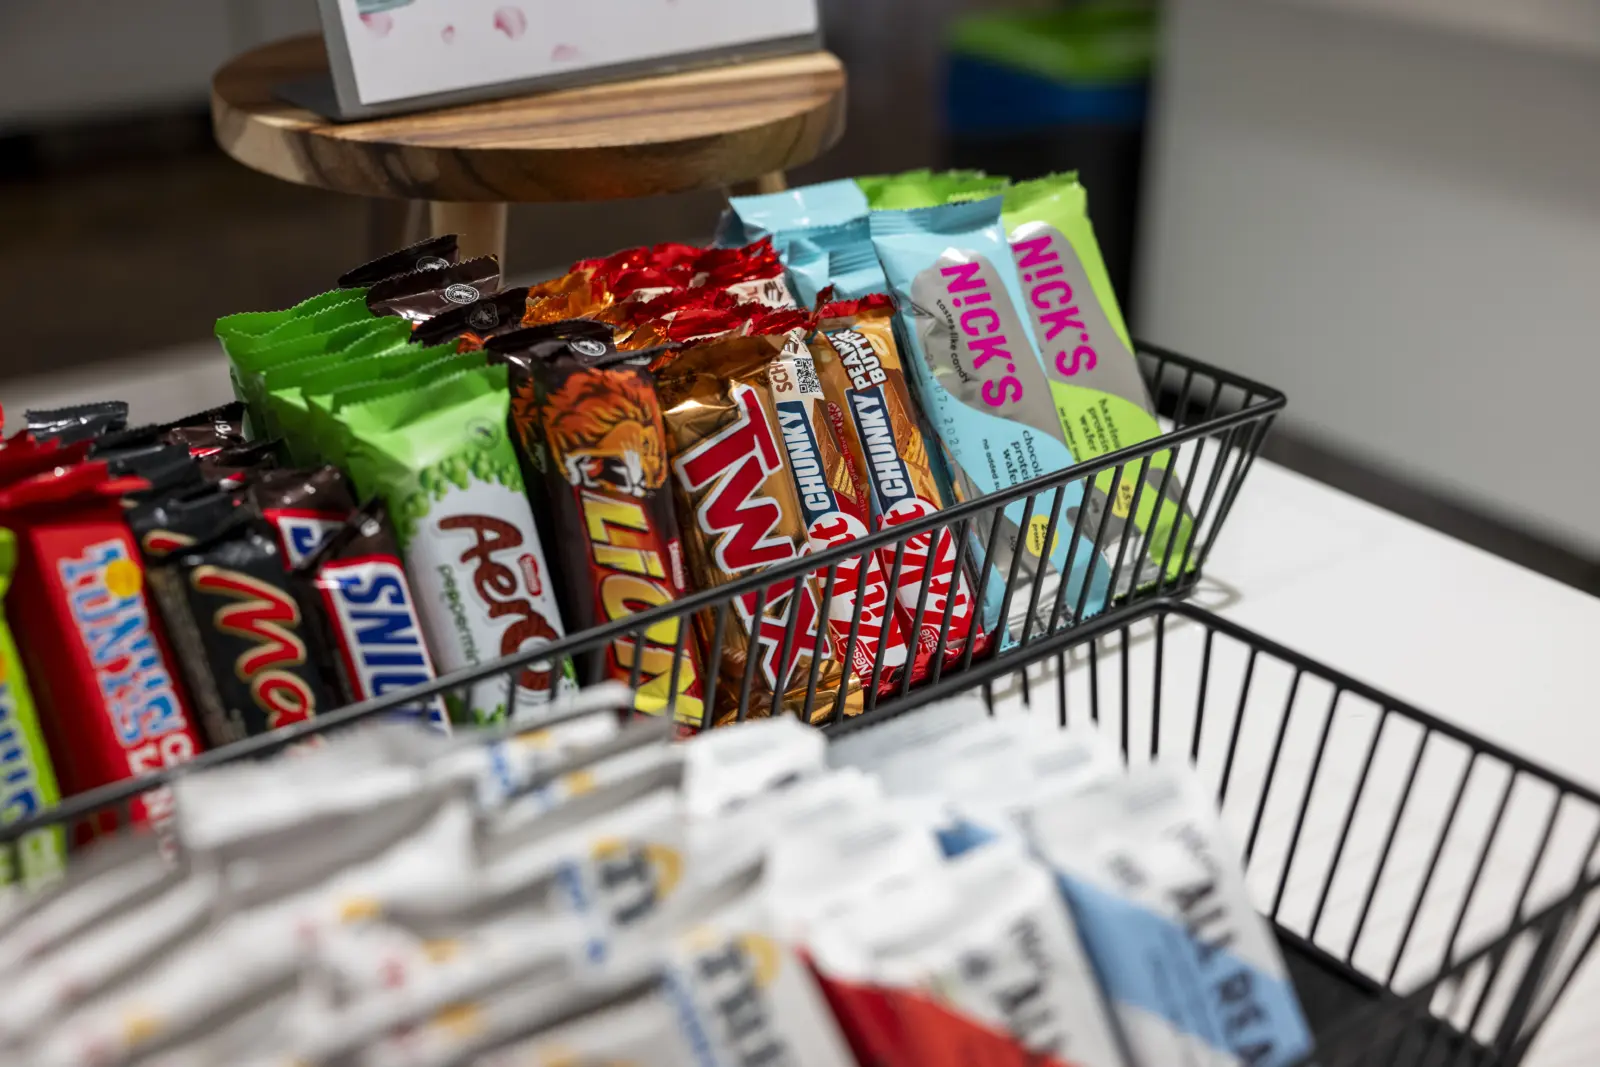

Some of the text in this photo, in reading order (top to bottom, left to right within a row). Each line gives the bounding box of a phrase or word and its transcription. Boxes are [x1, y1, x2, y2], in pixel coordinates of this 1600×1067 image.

[936, 299, 971, 384] tastes like candy
[777, 410, 832, 512] CHUNKY
[854, 394, 908, 498] CHUNKY
[982, 438, 990, 450] no
[986, 452, 999, 480] added
[1010, 440, 1031, 481] protei
[1079, 415, 1097, 452] wafer
[1098, 398, 1121, 449] hazelnu
[438, 514, 562, 691] Aero
[438, 564, 482, 667] peppermin
